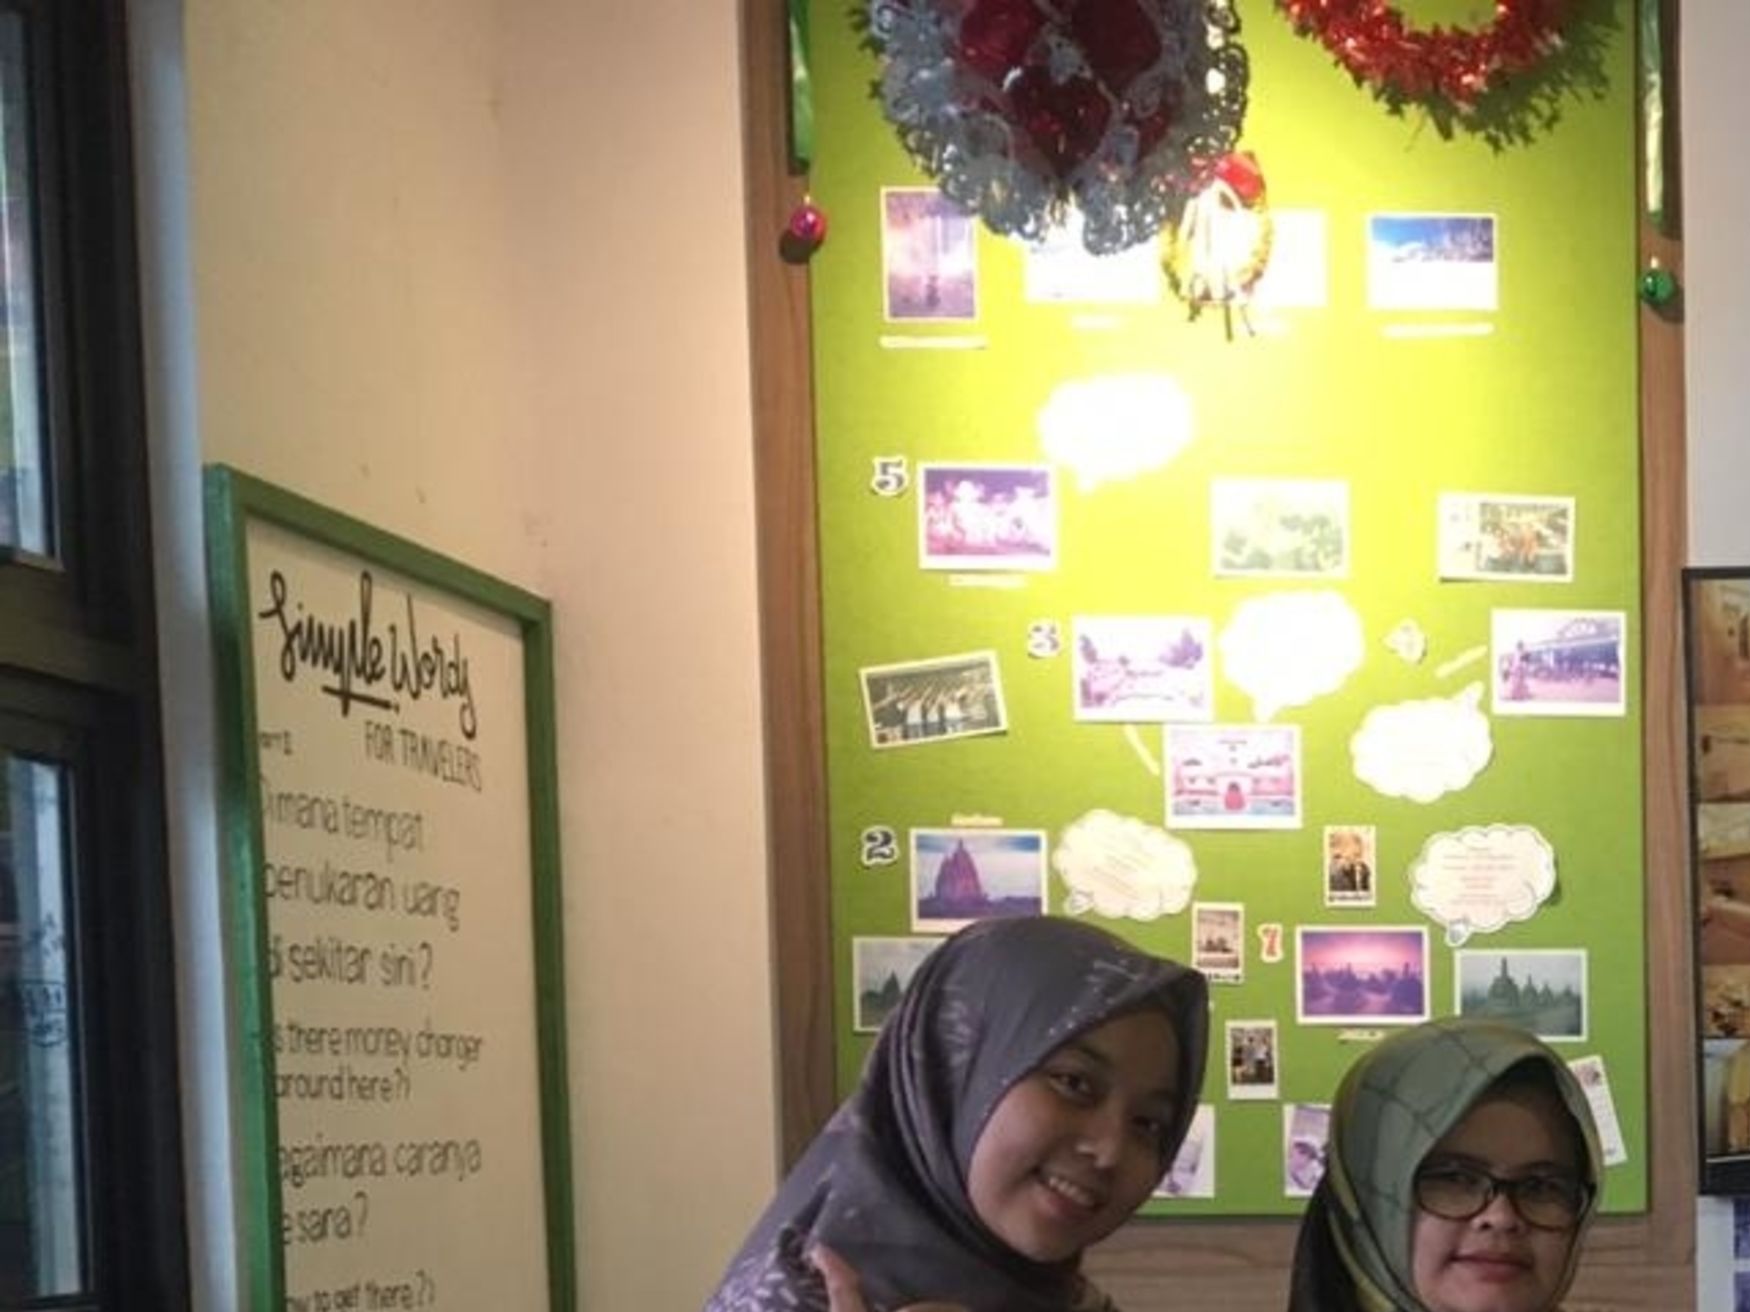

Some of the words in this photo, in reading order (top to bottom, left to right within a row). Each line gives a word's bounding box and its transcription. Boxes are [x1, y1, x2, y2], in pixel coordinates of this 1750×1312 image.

[259, 570, 385, 717] Simple
[364, 720, 397, 764] FOR
[398, 727, 482, 792] TRAVELERS
